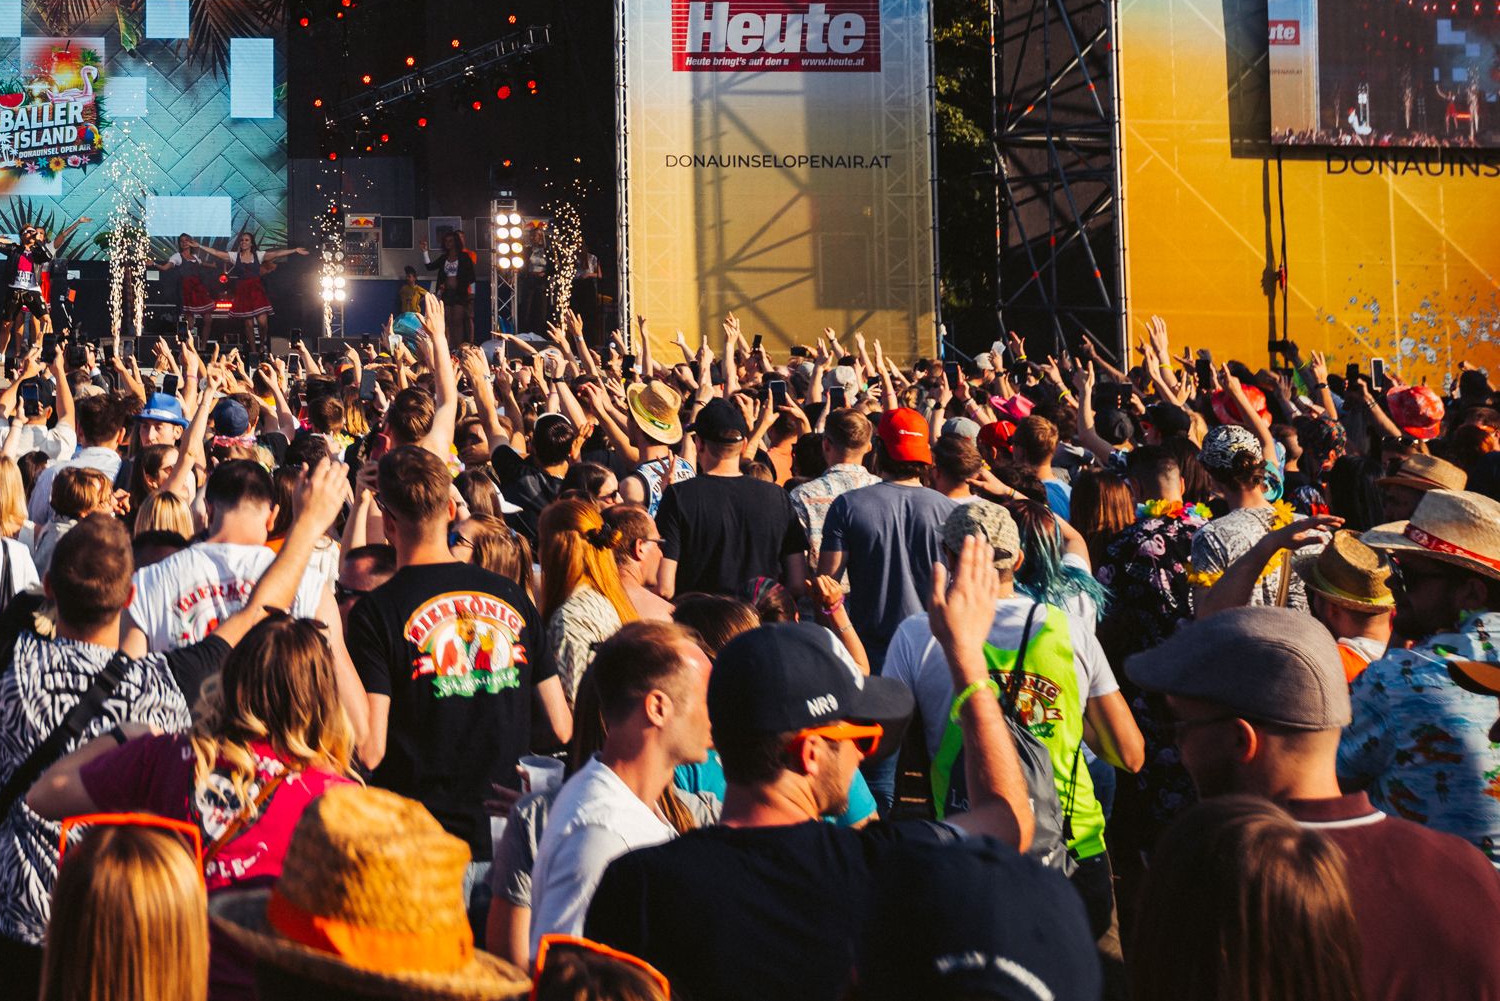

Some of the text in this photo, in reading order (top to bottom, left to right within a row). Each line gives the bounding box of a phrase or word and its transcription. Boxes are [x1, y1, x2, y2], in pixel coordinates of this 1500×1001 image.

[686, 1, 866, 54] Heute
[685, 57, 865, 68] Heute bringt's auf den www.heute.at
[0, 101, 84, 133] BALLER
[13, 125, 78, 150] ISLAND
[18, 143, 91, 159] DONAUINSEL OPEN AIR
[665, 155, 892, 169] DONAUINSELOPENAIR.AT
[409, 594, 521, 642] BIERKÖNIG
